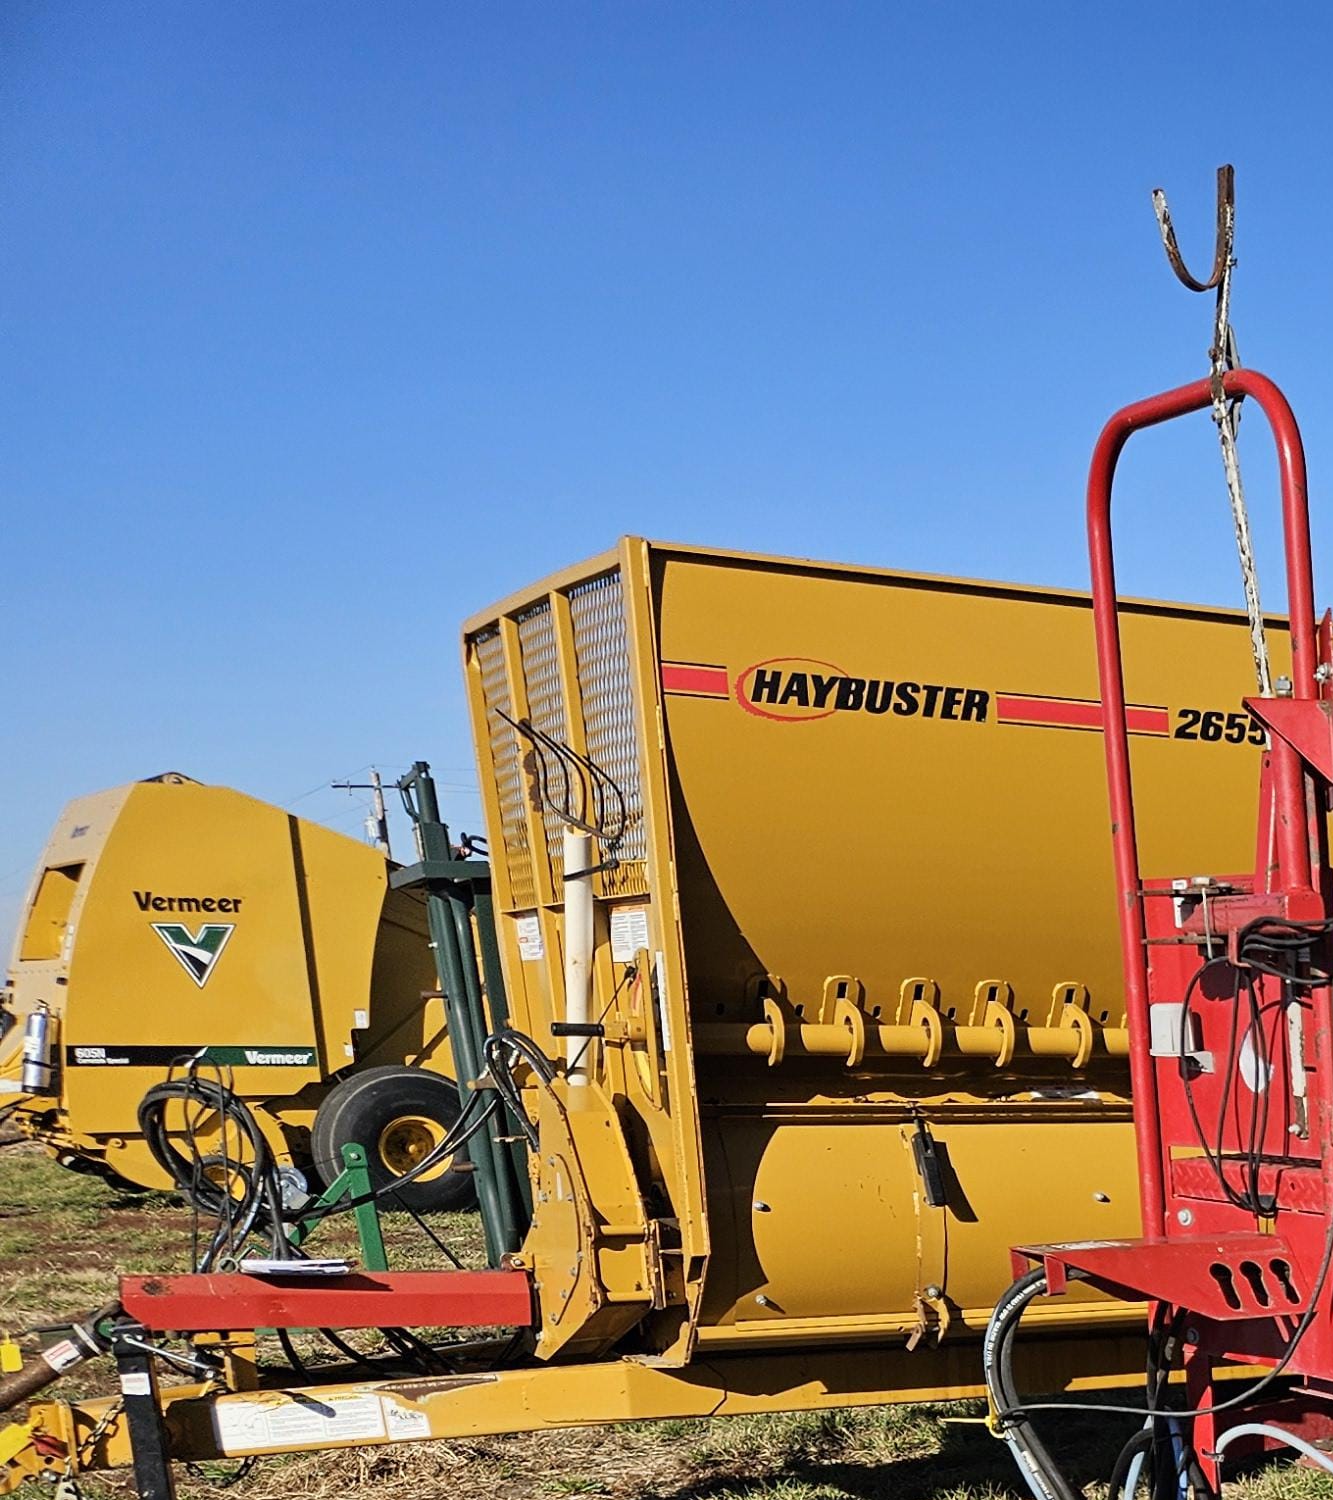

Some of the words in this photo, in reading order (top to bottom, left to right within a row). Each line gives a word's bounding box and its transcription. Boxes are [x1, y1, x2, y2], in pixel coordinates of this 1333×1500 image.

[751, 669, 990, 723] HAYBUSTER
[1174, 709, 1267, 745] 2655
[133, 891, 242, 913] Vermeer
[245, 1050, 310, 1064] Vermeer
